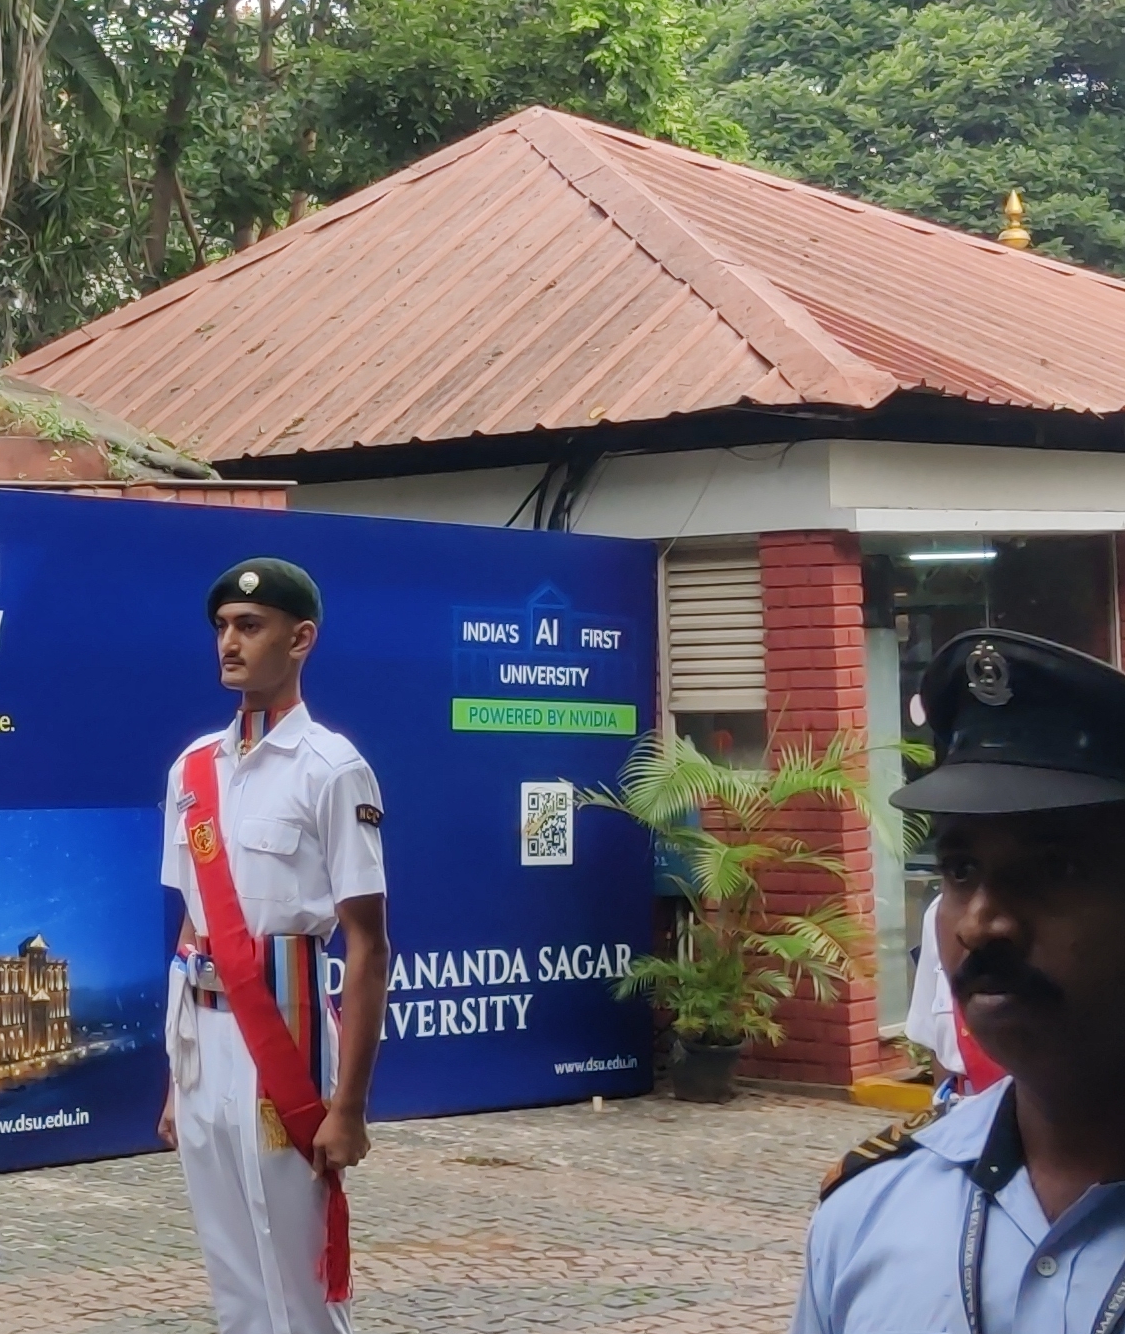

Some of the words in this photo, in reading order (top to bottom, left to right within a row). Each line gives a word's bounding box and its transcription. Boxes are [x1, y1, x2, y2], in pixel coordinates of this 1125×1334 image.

[462, 621, 520, 644] INDIA'S
[536, 618, 559, 646] AI
[581, 628, 622, 649] FIRST
[500, 664, 589, 687] UNIVERSITY
[469, 706, 543, 726] POWERED
[547, 709, 566, 726] BY
[569, 710, 617, 728] NVIDIA
[538, 944, 633, 982] SAGAR
[554, 1055, 638, 1075] www.dsu.edu.in
